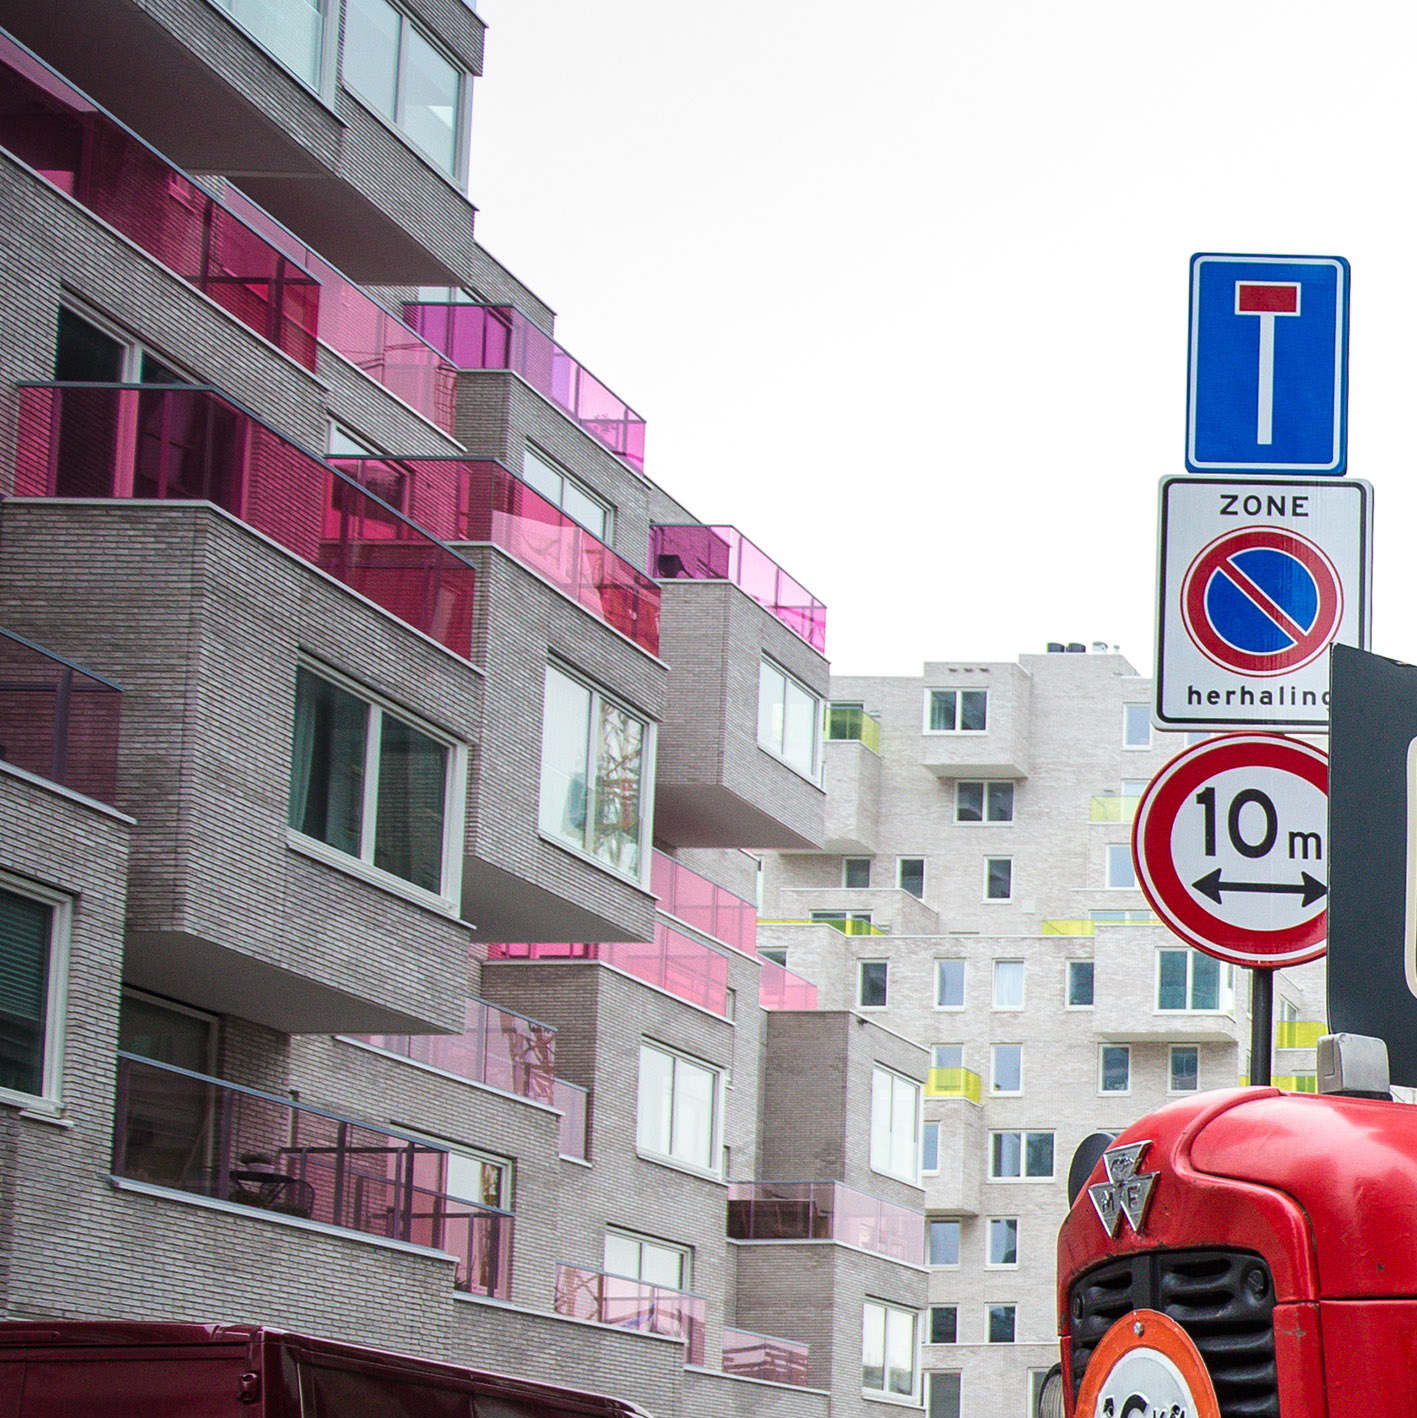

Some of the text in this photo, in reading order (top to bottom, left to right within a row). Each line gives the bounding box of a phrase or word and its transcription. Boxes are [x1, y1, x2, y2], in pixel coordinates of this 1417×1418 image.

[1219, 494, 1309, 517] ZONE
[1195, 786, 1322, 860] 10 m
